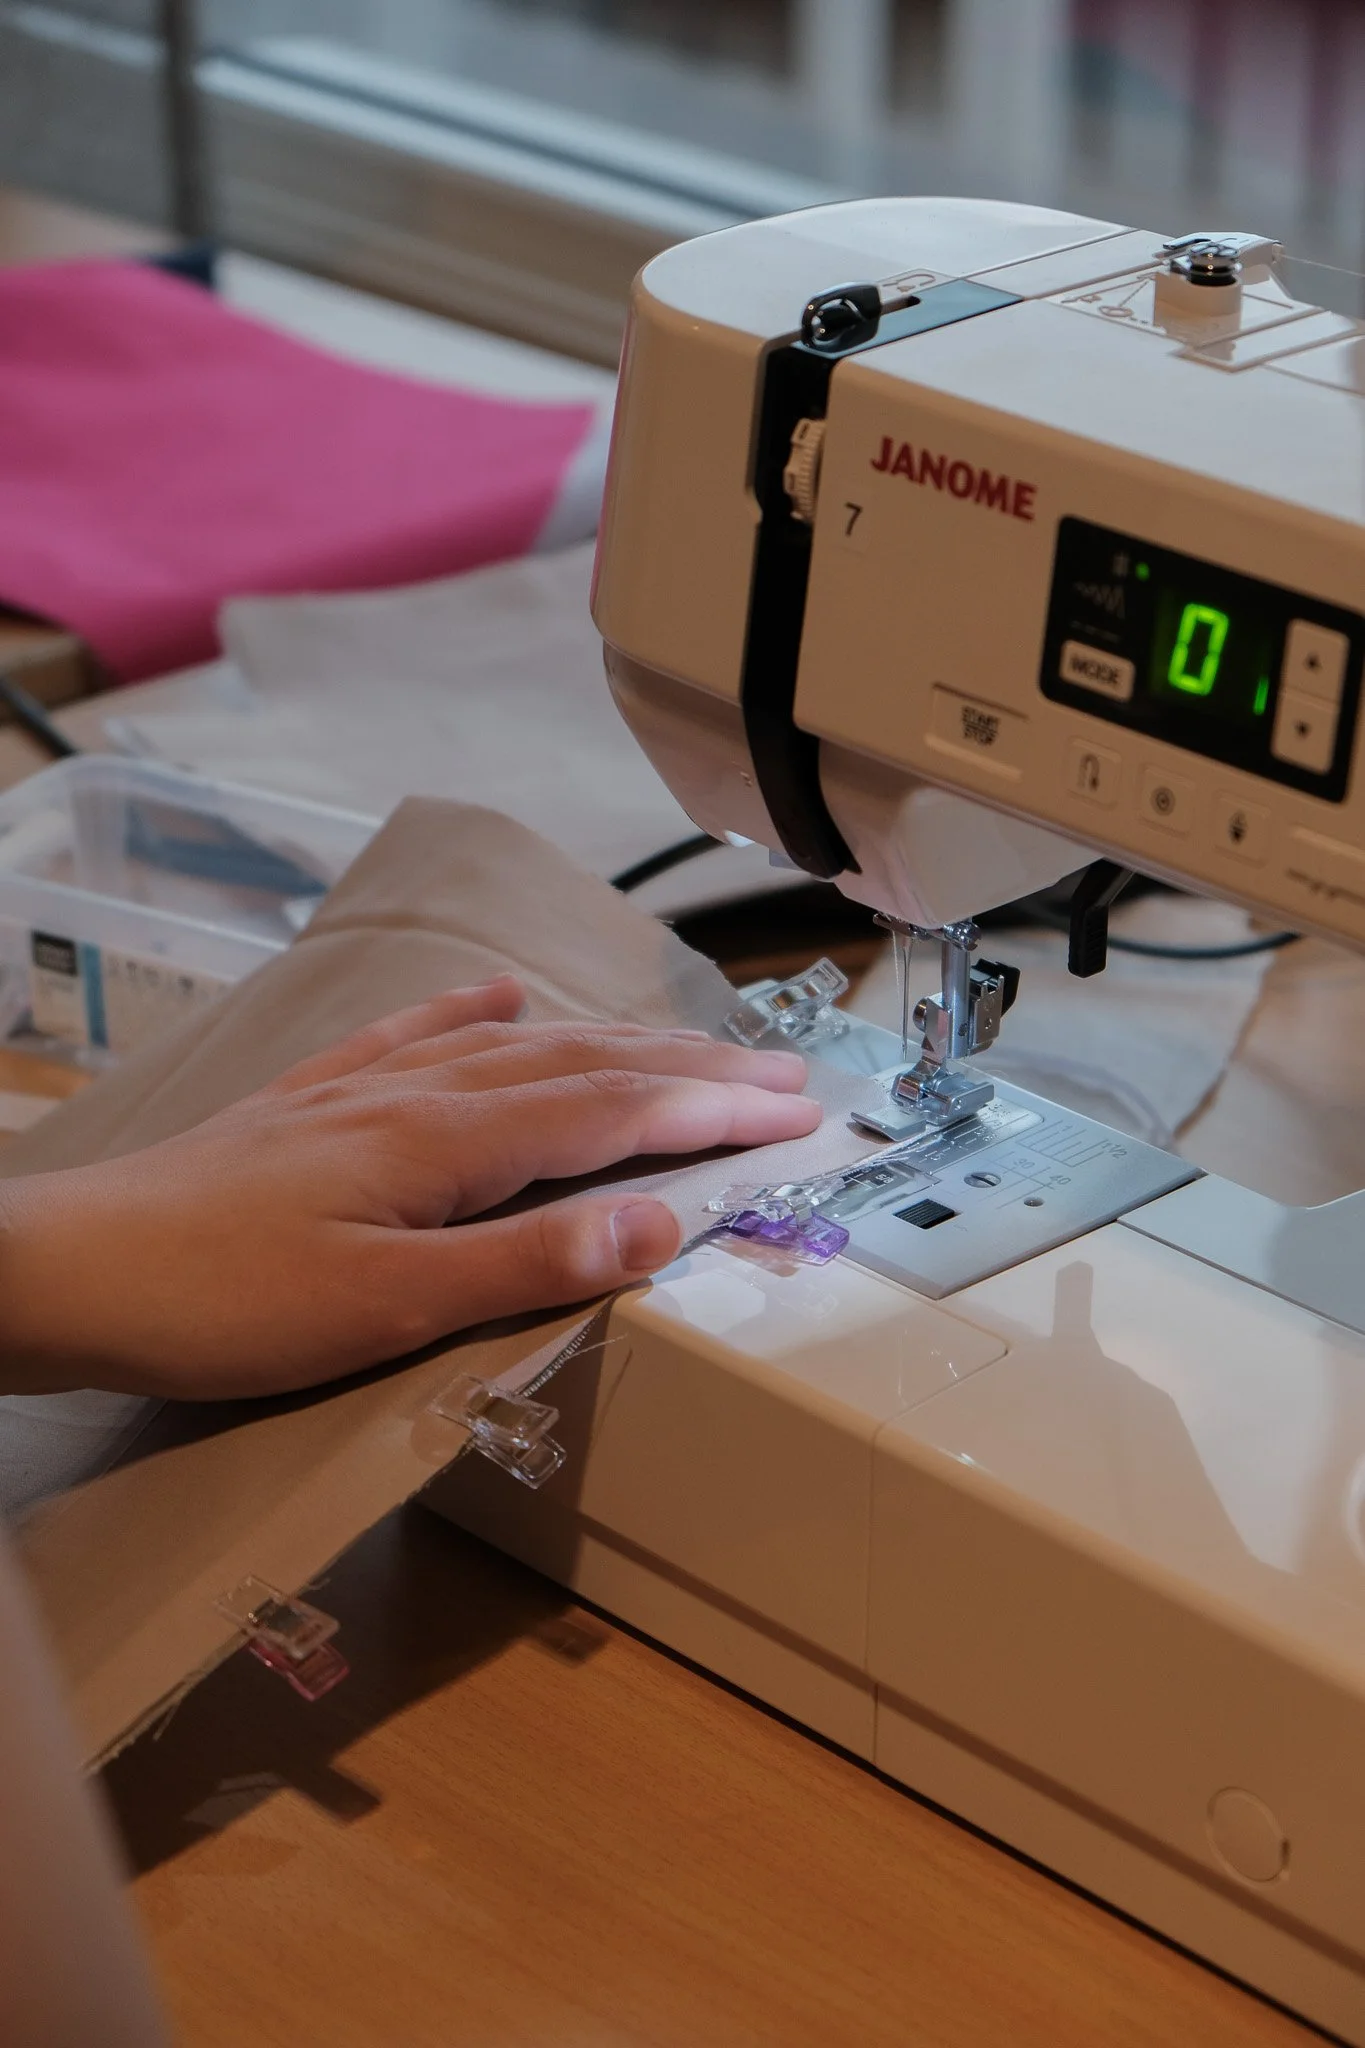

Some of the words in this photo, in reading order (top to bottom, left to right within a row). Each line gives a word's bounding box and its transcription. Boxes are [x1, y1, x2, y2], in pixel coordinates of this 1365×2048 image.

[871, 436, 1037, 523] JANOME
[844, 503, 863, 536] 7
[1167, 603, 1230, 696] 0
[1070, 654, 1120, 686] MODE
[961, 706, 1001, 729] START
[963, 726, 998, 746] STOP
